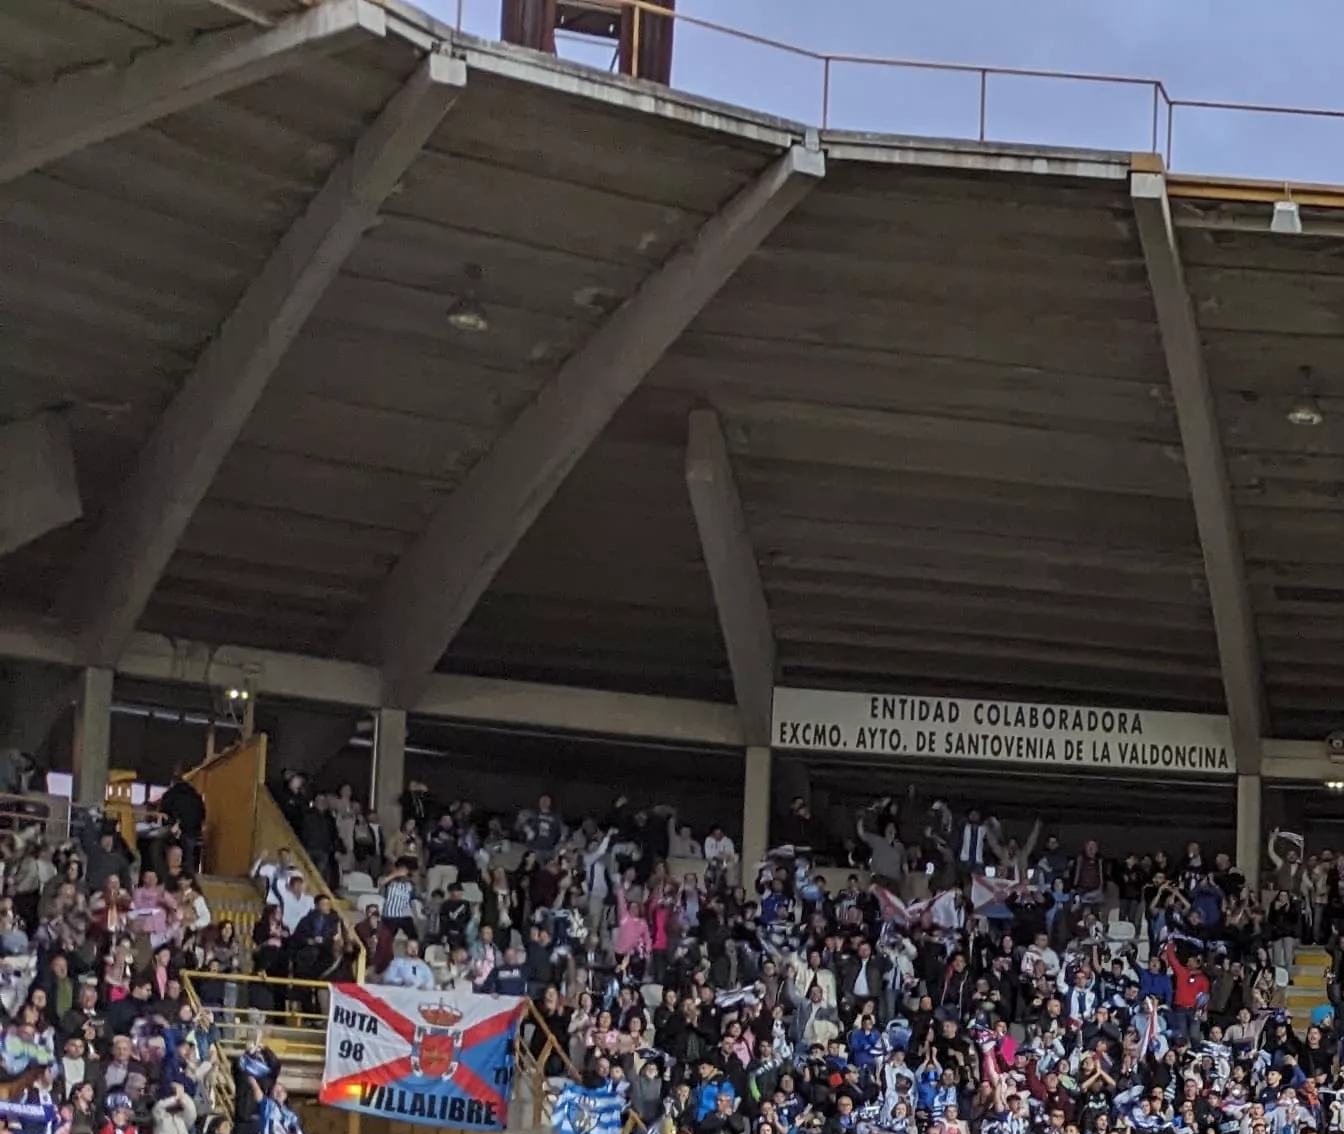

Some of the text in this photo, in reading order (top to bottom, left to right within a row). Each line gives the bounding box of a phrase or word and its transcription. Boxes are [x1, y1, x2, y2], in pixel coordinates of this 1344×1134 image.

[870, 697, 1144, 735] ENTIDAD COLABORADORA
[779, 723, 1230, 770] EXCMO. AYTO. DE SANTOVENIA DE LA VALDONCINA
[333, 1005, 379, 1035] RUTA
[338, 1039, 365, 1062] 98
[358, 1081, 497, 1126] VILLALIBRE
